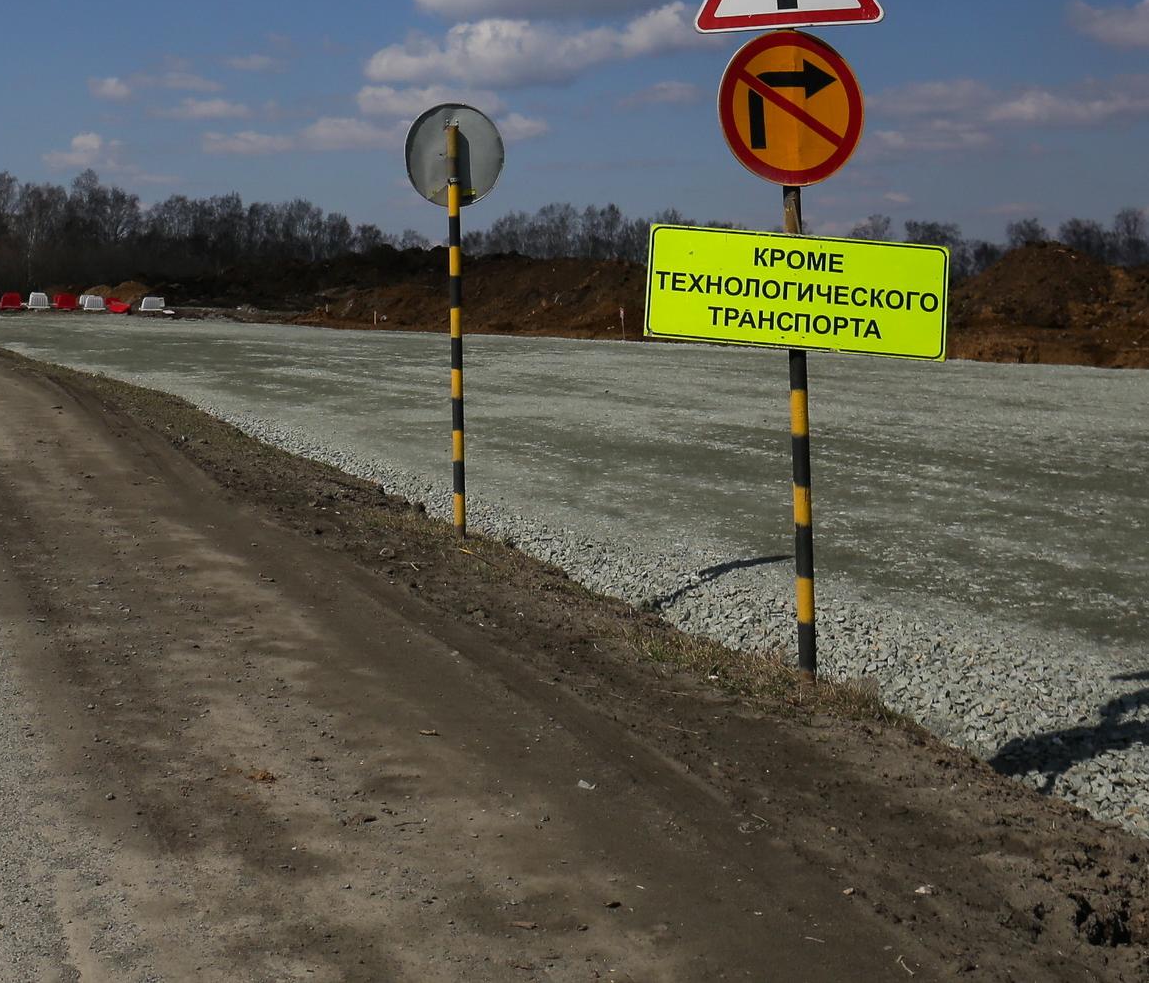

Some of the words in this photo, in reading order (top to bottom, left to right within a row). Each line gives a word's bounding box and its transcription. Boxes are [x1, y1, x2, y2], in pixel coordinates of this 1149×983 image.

[754, 247, 845, 274] КРОМЕ
[655, 270, 939, 313] ТЕХНОЛОГИЧЕСКОГО
[708, 306, 882, 340] ТРАНСПОРТА
